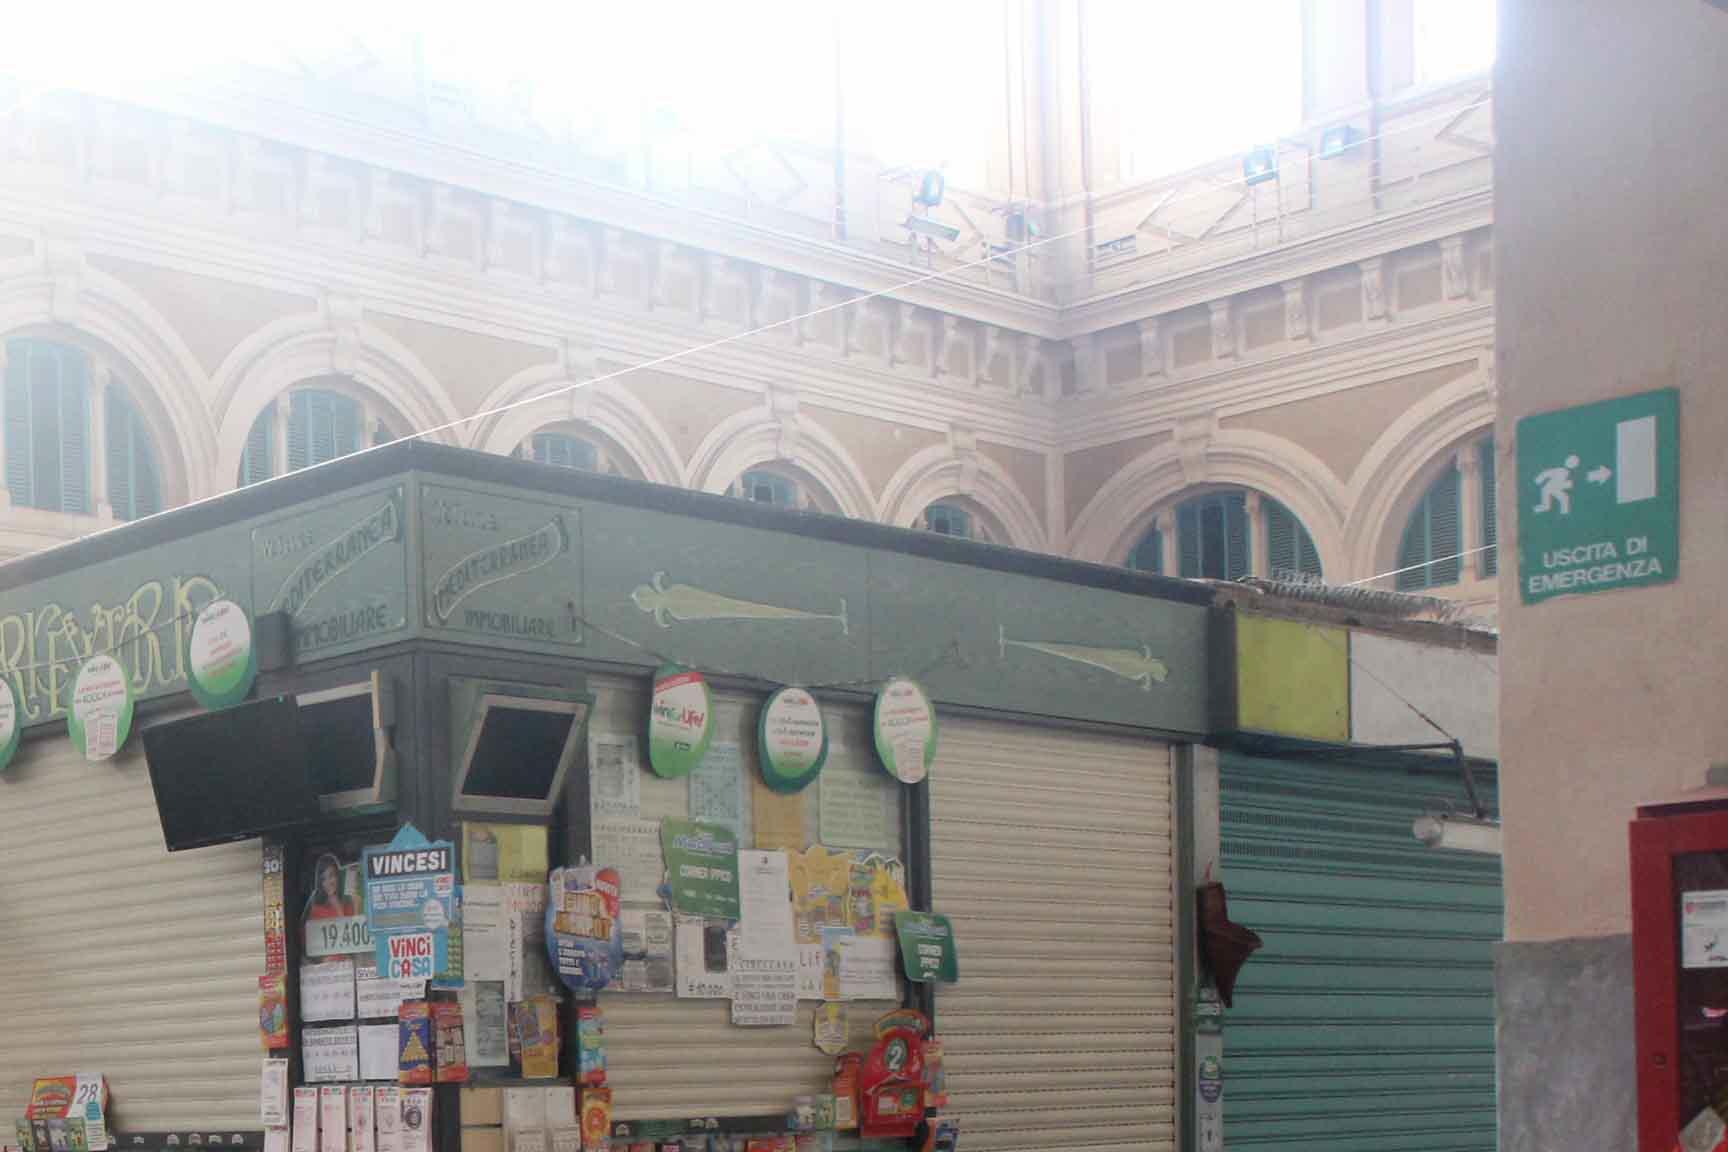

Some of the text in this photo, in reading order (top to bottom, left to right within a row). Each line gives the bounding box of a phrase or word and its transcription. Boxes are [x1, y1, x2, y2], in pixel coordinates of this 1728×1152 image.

[1543, 536, 1648, 568] USCITA DI
[1528, 557, 1662, 592] EMERGENZA
[372, 850, 446, 876] VINCESI
[391, 957, 431, 978] CASA
